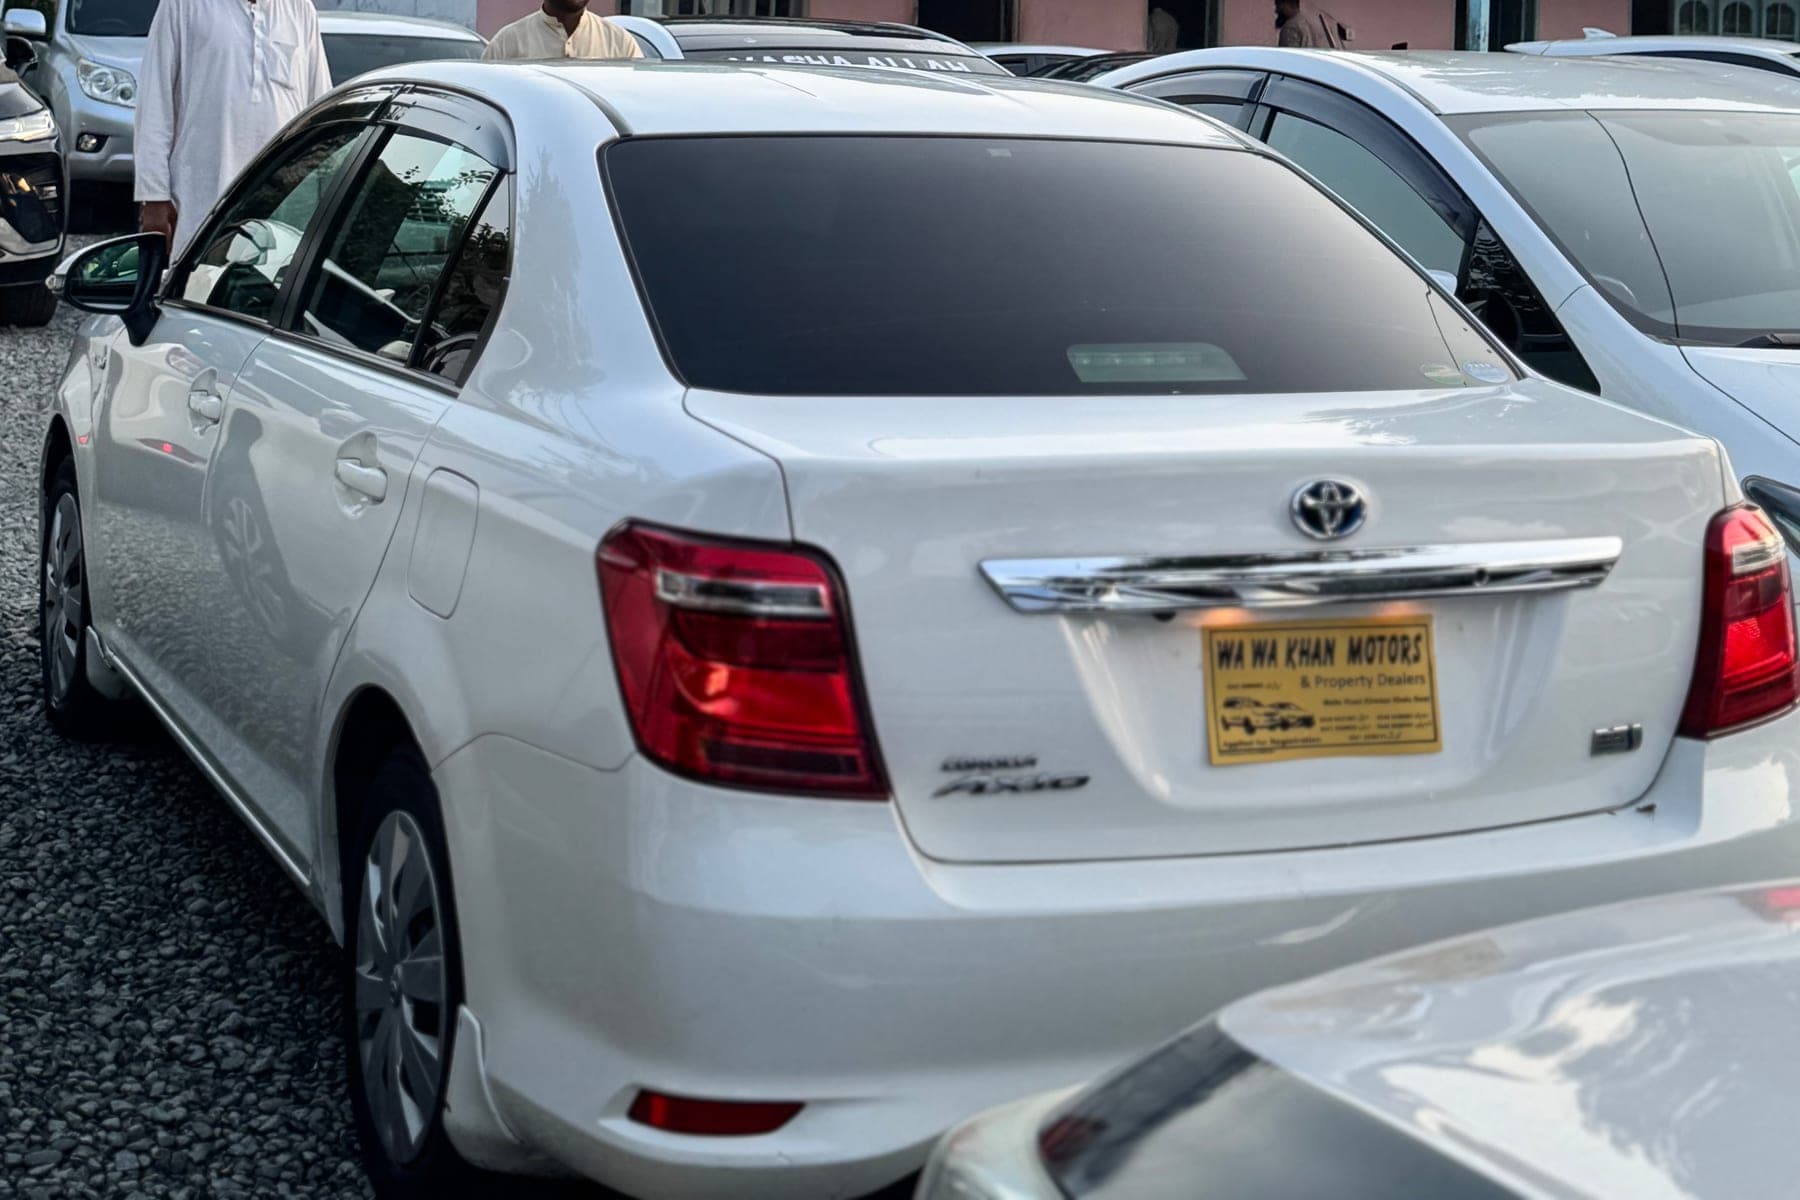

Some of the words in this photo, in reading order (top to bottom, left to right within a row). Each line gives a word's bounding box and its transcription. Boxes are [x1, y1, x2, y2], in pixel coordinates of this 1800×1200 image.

[1217, 638, 1244, 670] WA
[1252, 638, 1278, 668] WA
[1285, 636, 1336, 668] KHAN
[1347, 633, 1422, 666] MOTORS
[1314, 675, 1373, 691] Property
[1377, 673, 1426, 687] Dealers
